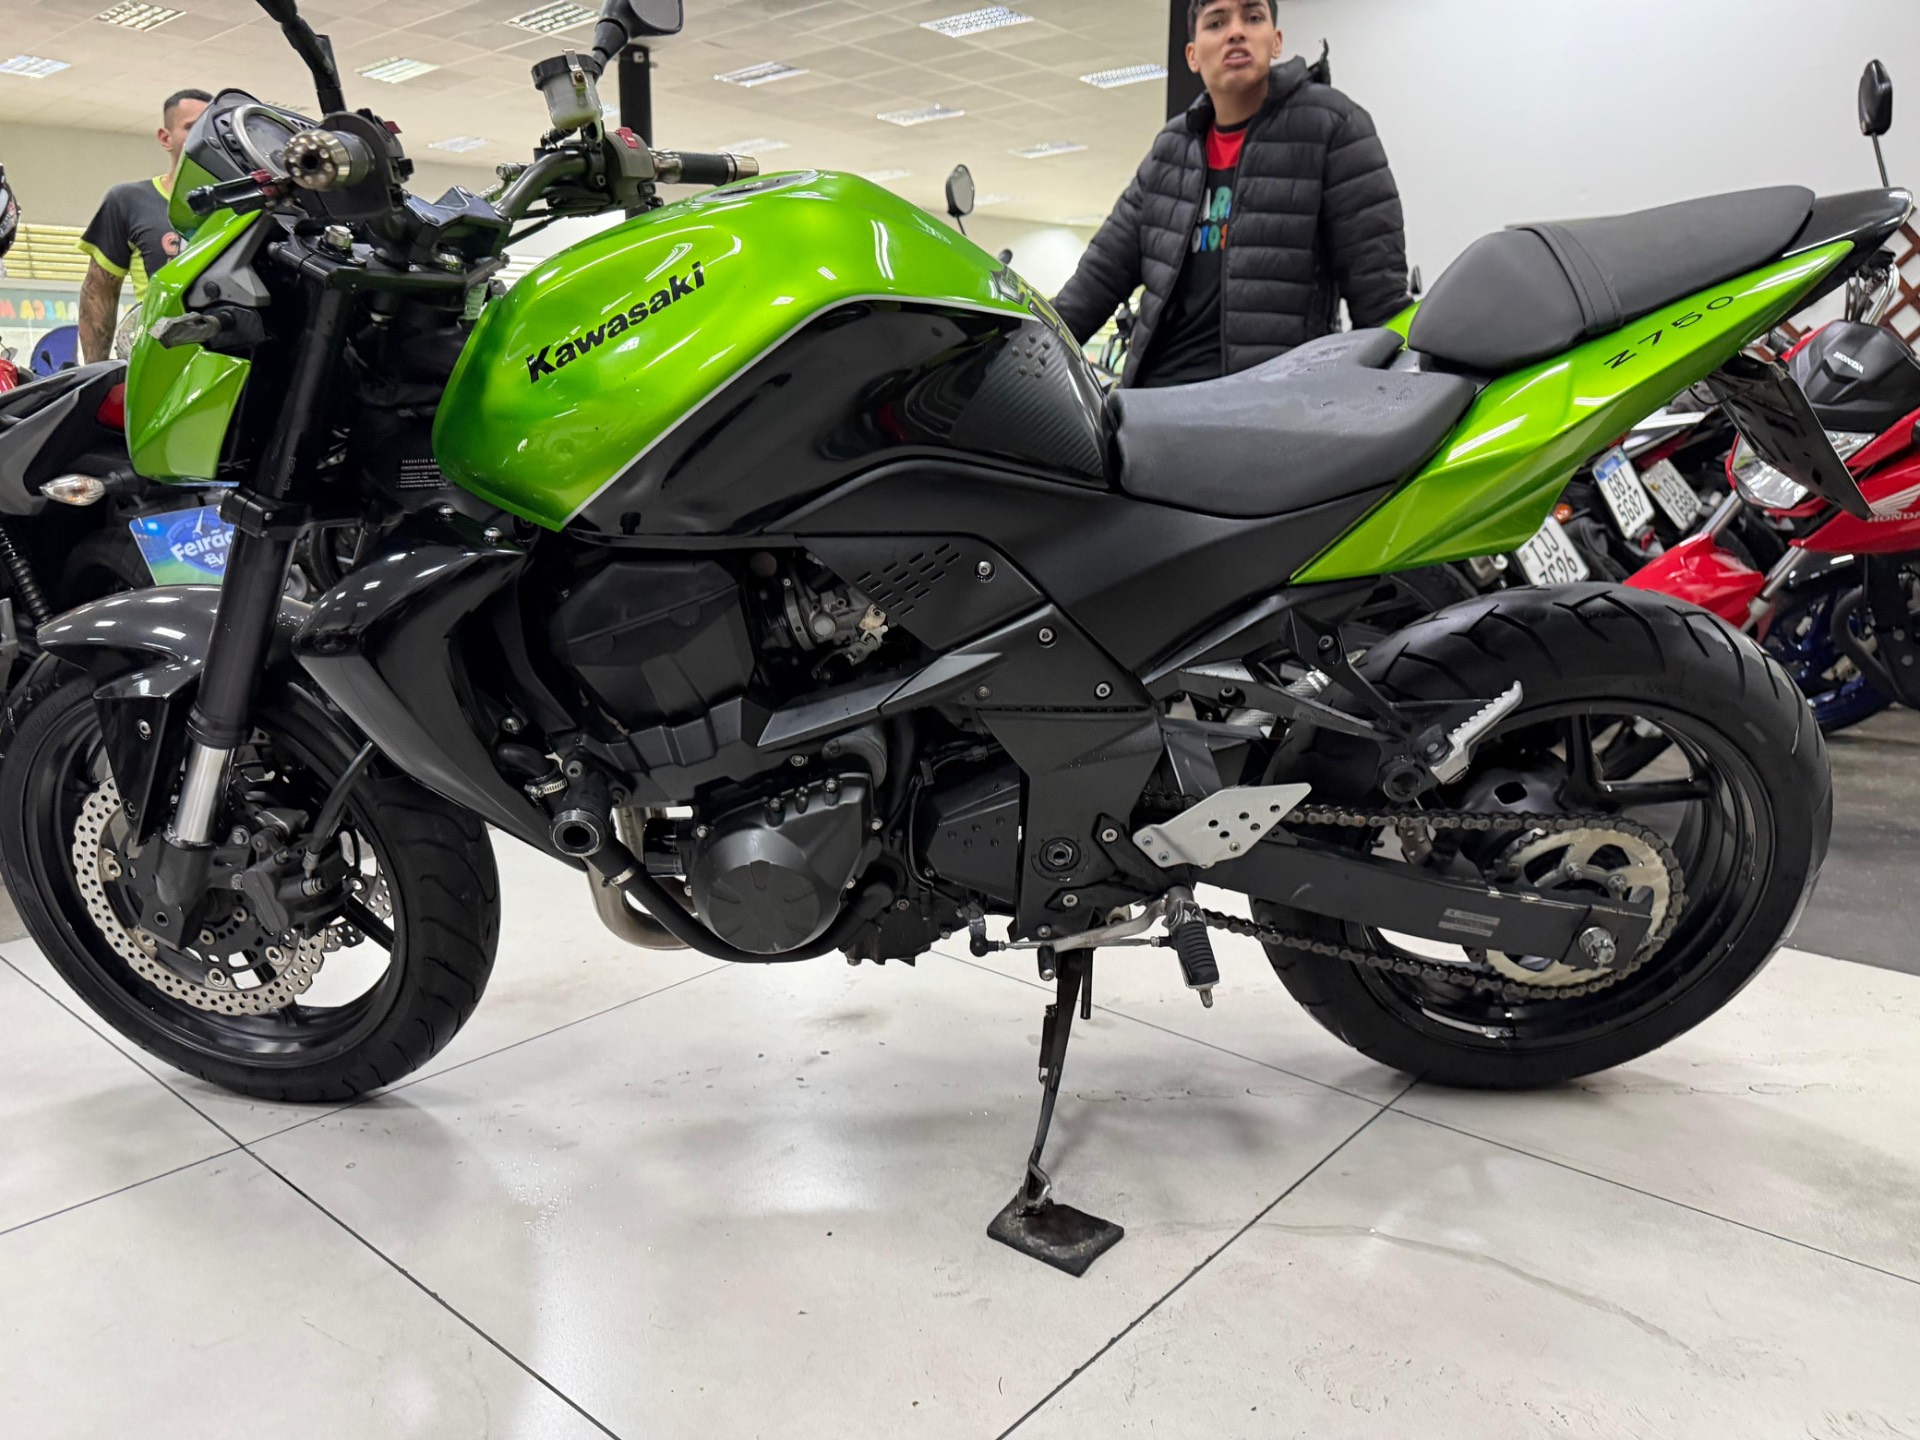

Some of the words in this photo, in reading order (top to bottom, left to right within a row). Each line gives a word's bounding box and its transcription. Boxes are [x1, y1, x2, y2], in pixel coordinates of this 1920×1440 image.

[525, 261, 706, 384] Kawasaki
[1603, 295, 1733, 369] Z750
[1833, 351, 1864, 374] HONDA
[170, 528, 234, 562] Feirão
[1529, 527, 1559, 567] TJJ
